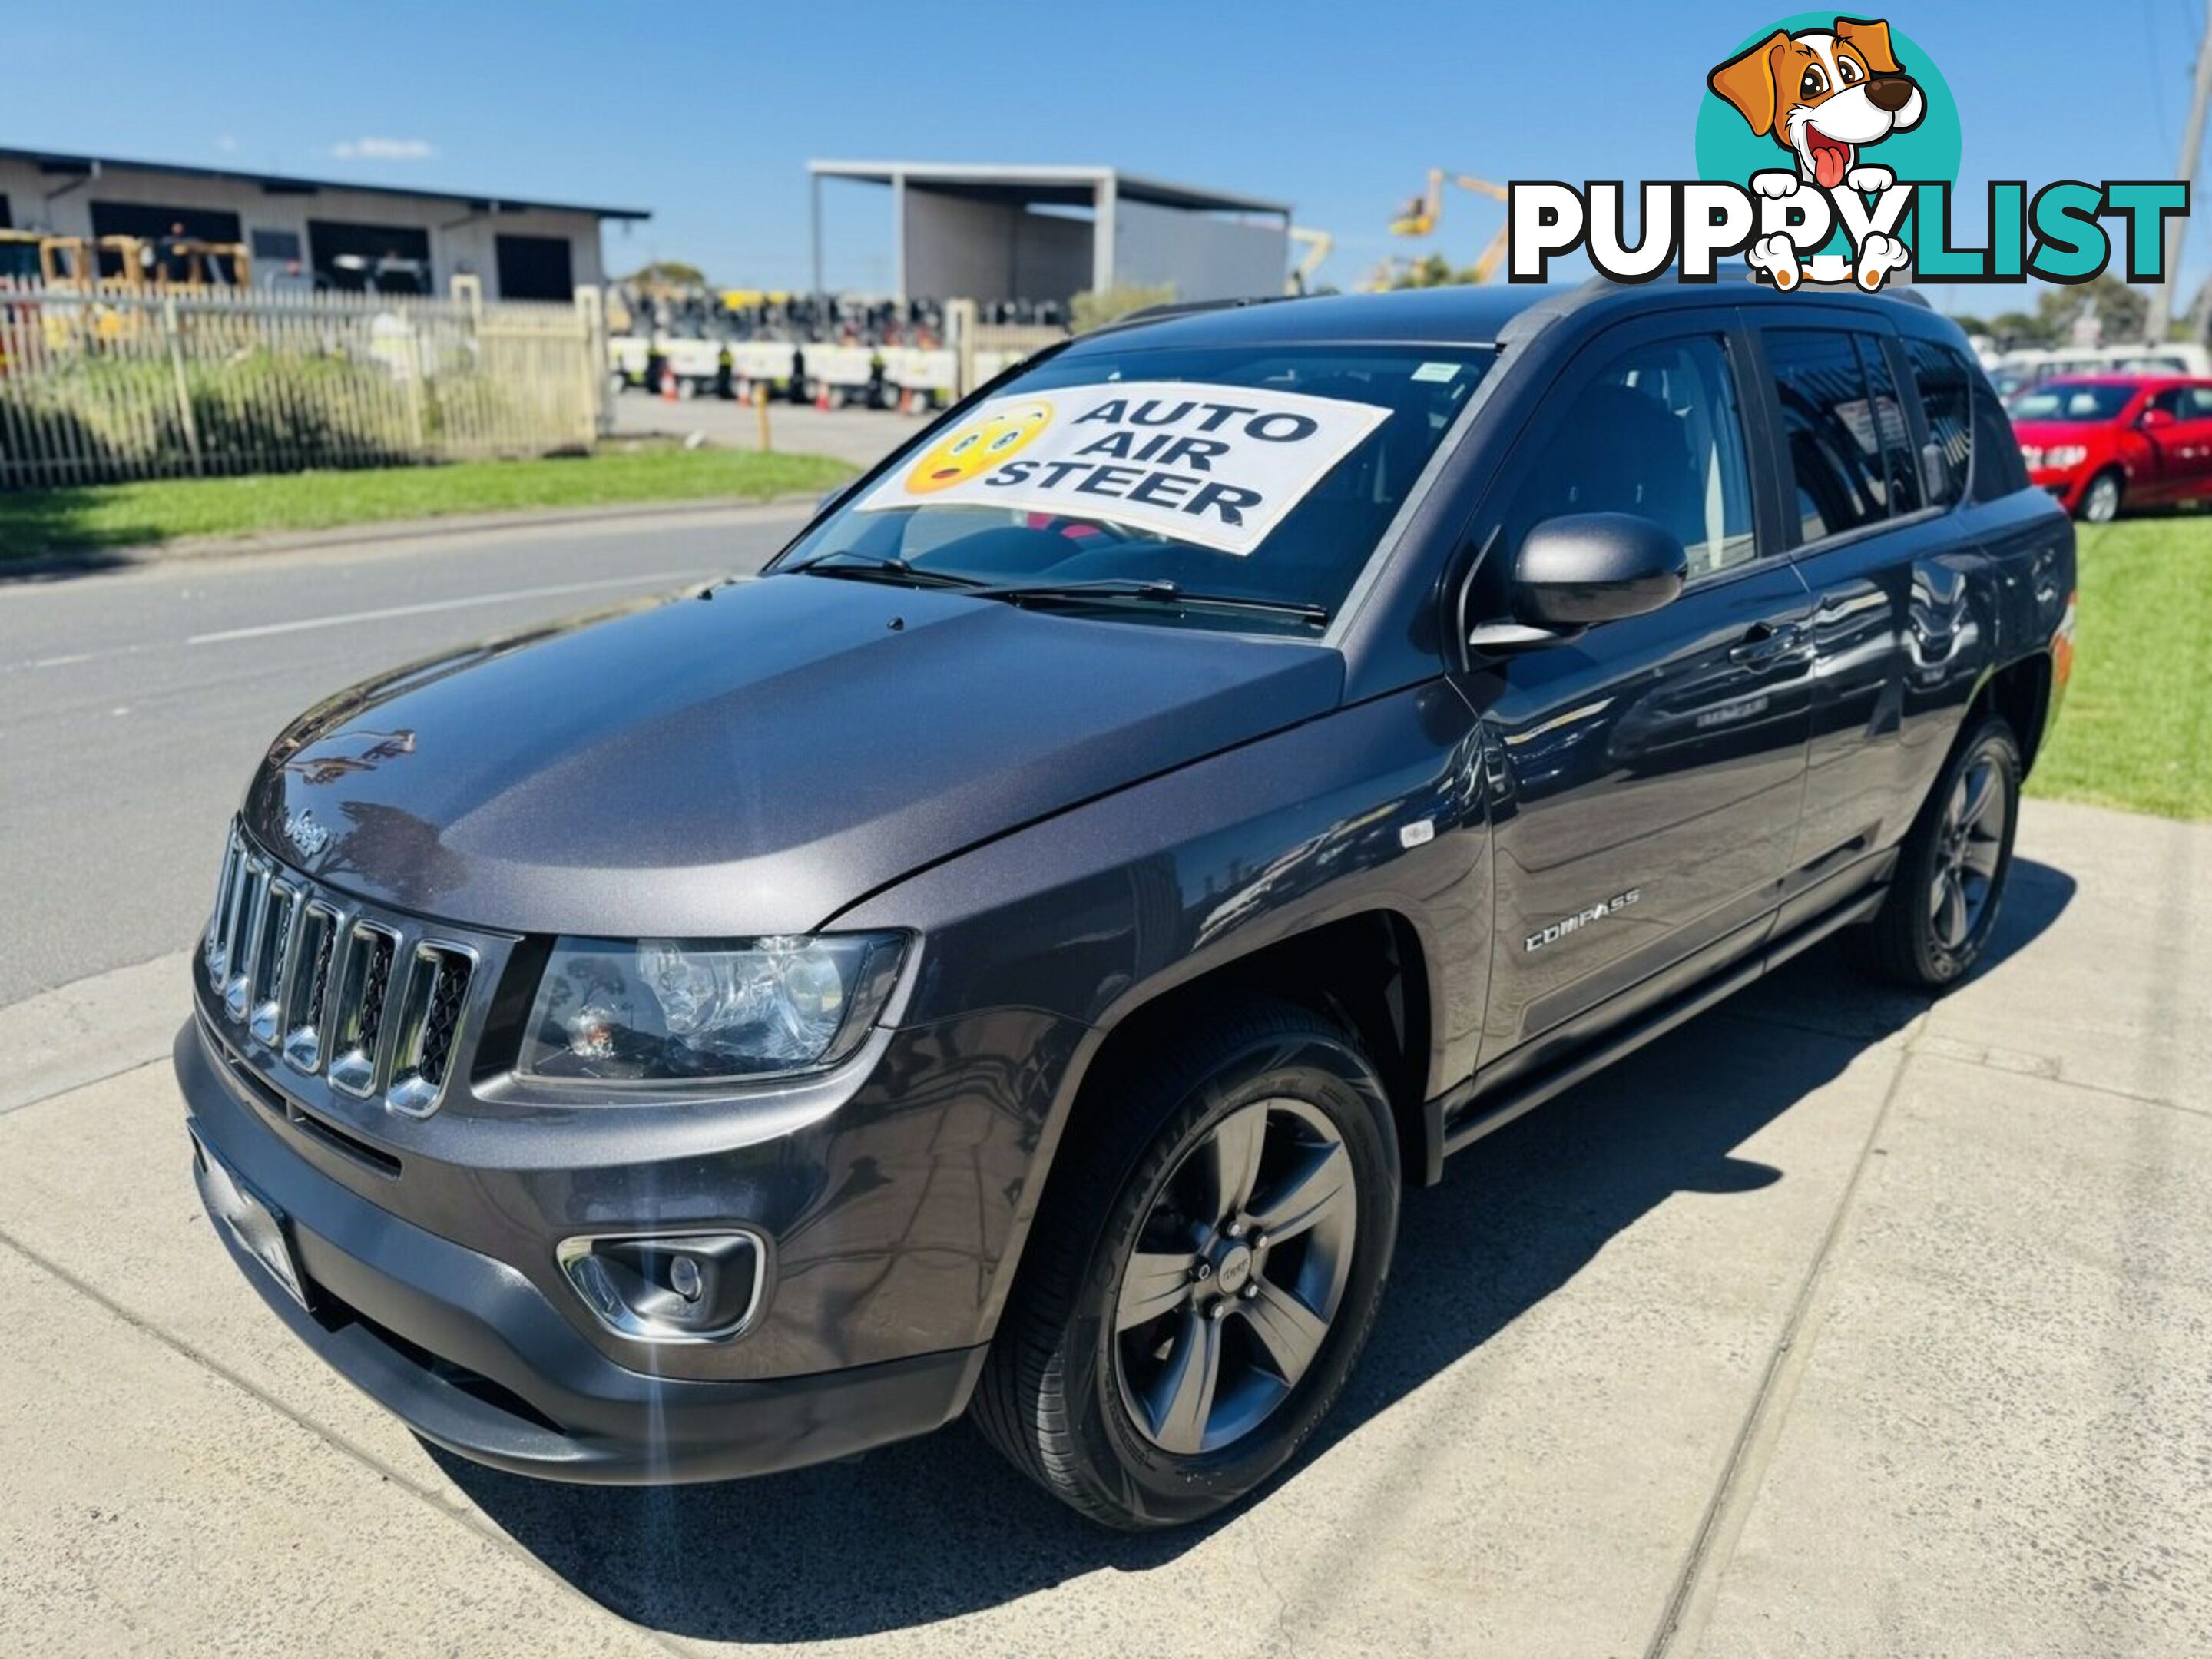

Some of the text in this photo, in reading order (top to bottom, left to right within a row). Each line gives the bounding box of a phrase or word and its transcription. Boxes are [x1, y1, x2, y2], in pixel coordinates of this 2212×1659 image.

[1072, 399, 1318, 442] AUTO
[1075, 432, 1230, 471] AIR
[985, 461, 1263, 526] STEER
[1525, 889, 1640, 952] COMPASS
